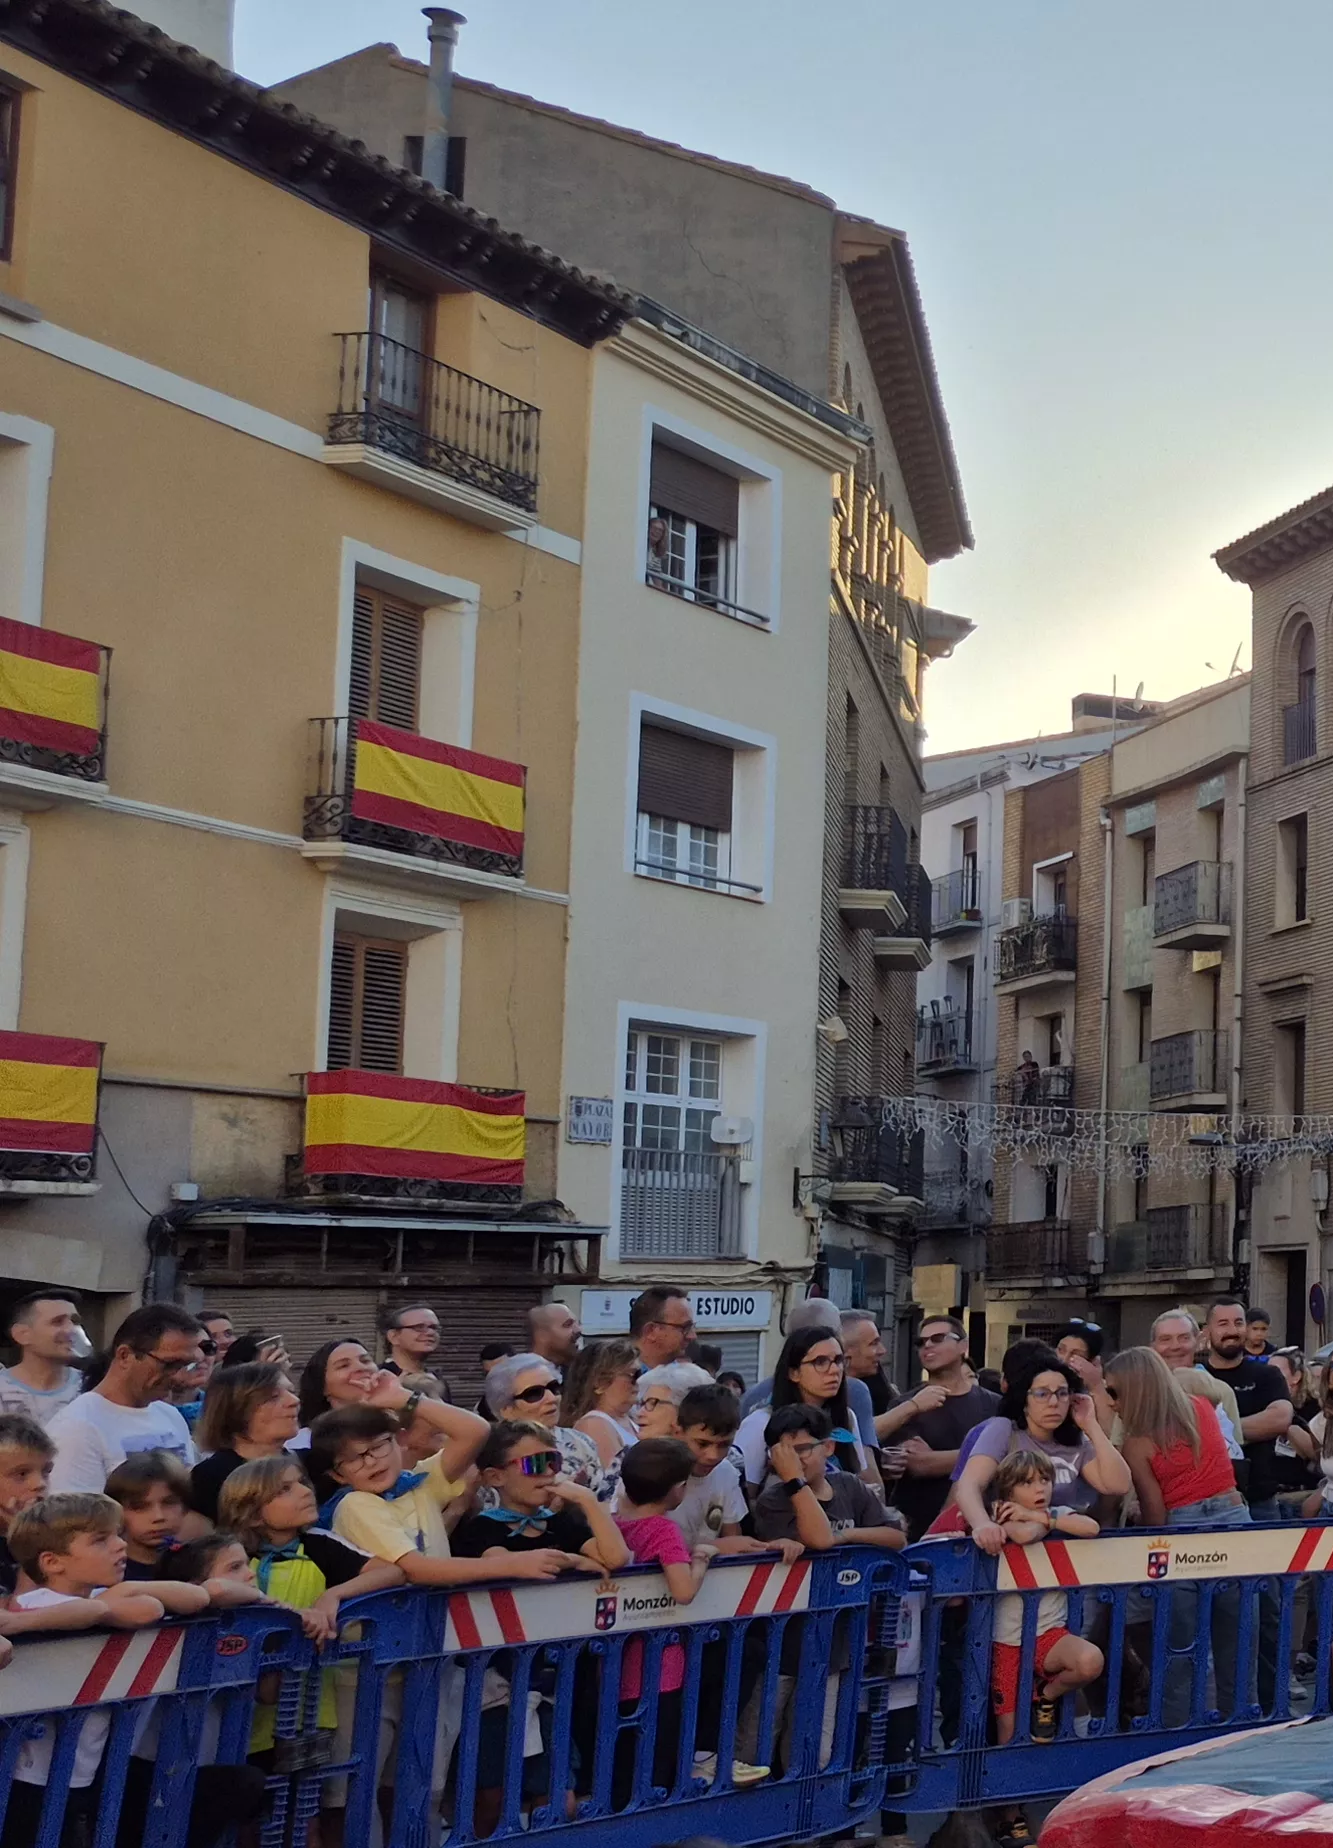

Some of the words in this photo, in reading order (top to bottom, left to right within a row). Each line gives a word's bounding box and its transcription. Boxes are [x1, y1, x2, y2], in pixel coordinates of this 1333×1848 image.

[572, 1121, 610, 1138] MAYOR
[696, 1297, 755, 1316] ESTUDIO
[1175, 1550, 1228, 1564] Monzón
[840, 1572, 858, 1582] JSP
[623, 1594, 676, 1612] Monzón
